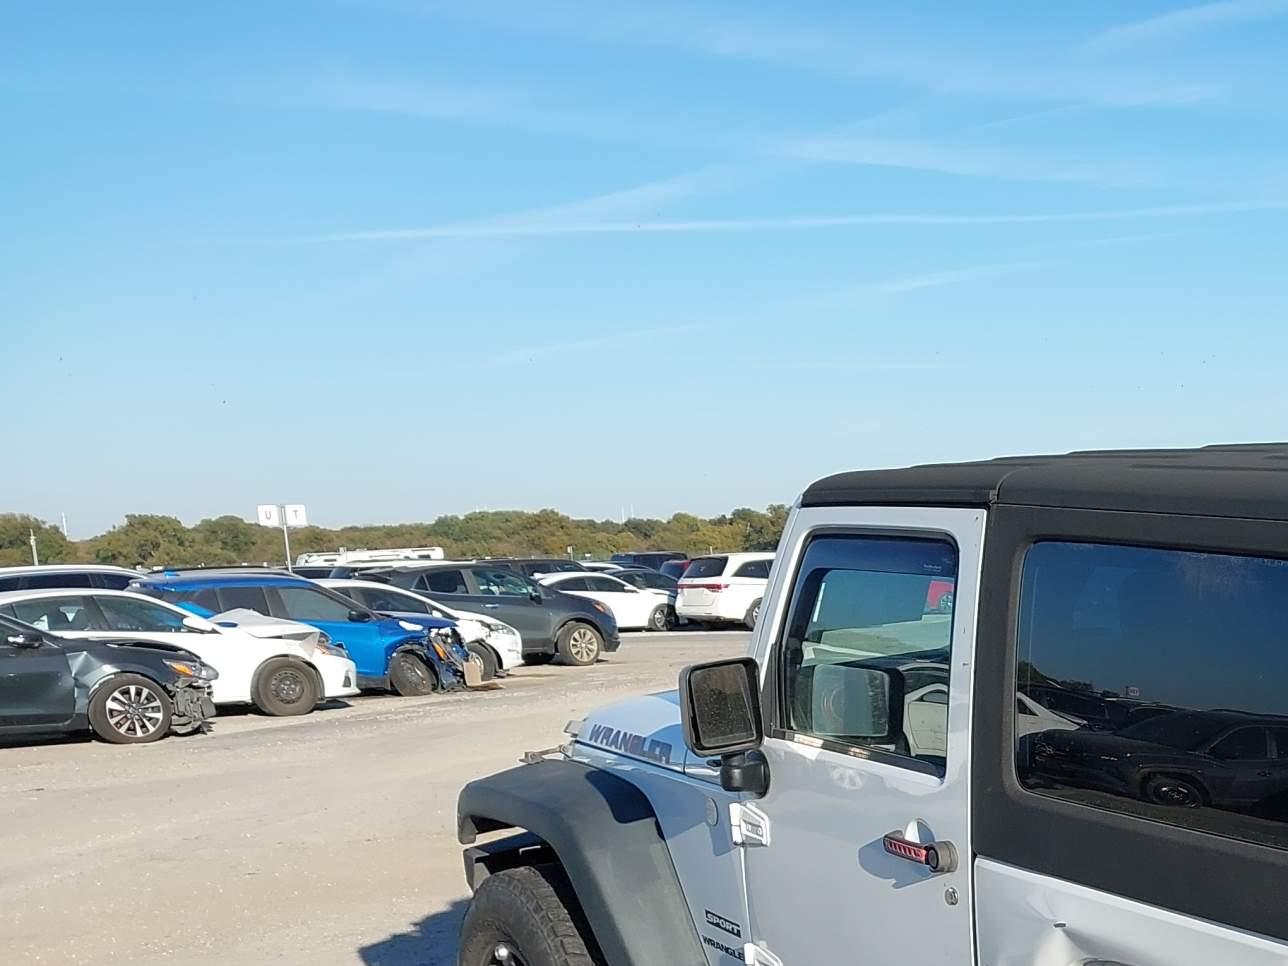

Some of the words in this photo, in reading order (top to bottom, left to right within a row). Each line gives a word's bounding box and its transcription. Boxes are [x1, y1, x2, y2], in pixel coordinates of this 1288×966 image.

[264, 510, 273, 520] U
[292, 510, 299, 520] T
[589, 724, 672, 765] WRANGLER
[706, 912, 740, 935] SPORT
[701, 934, 746, 961] WRANGLE
